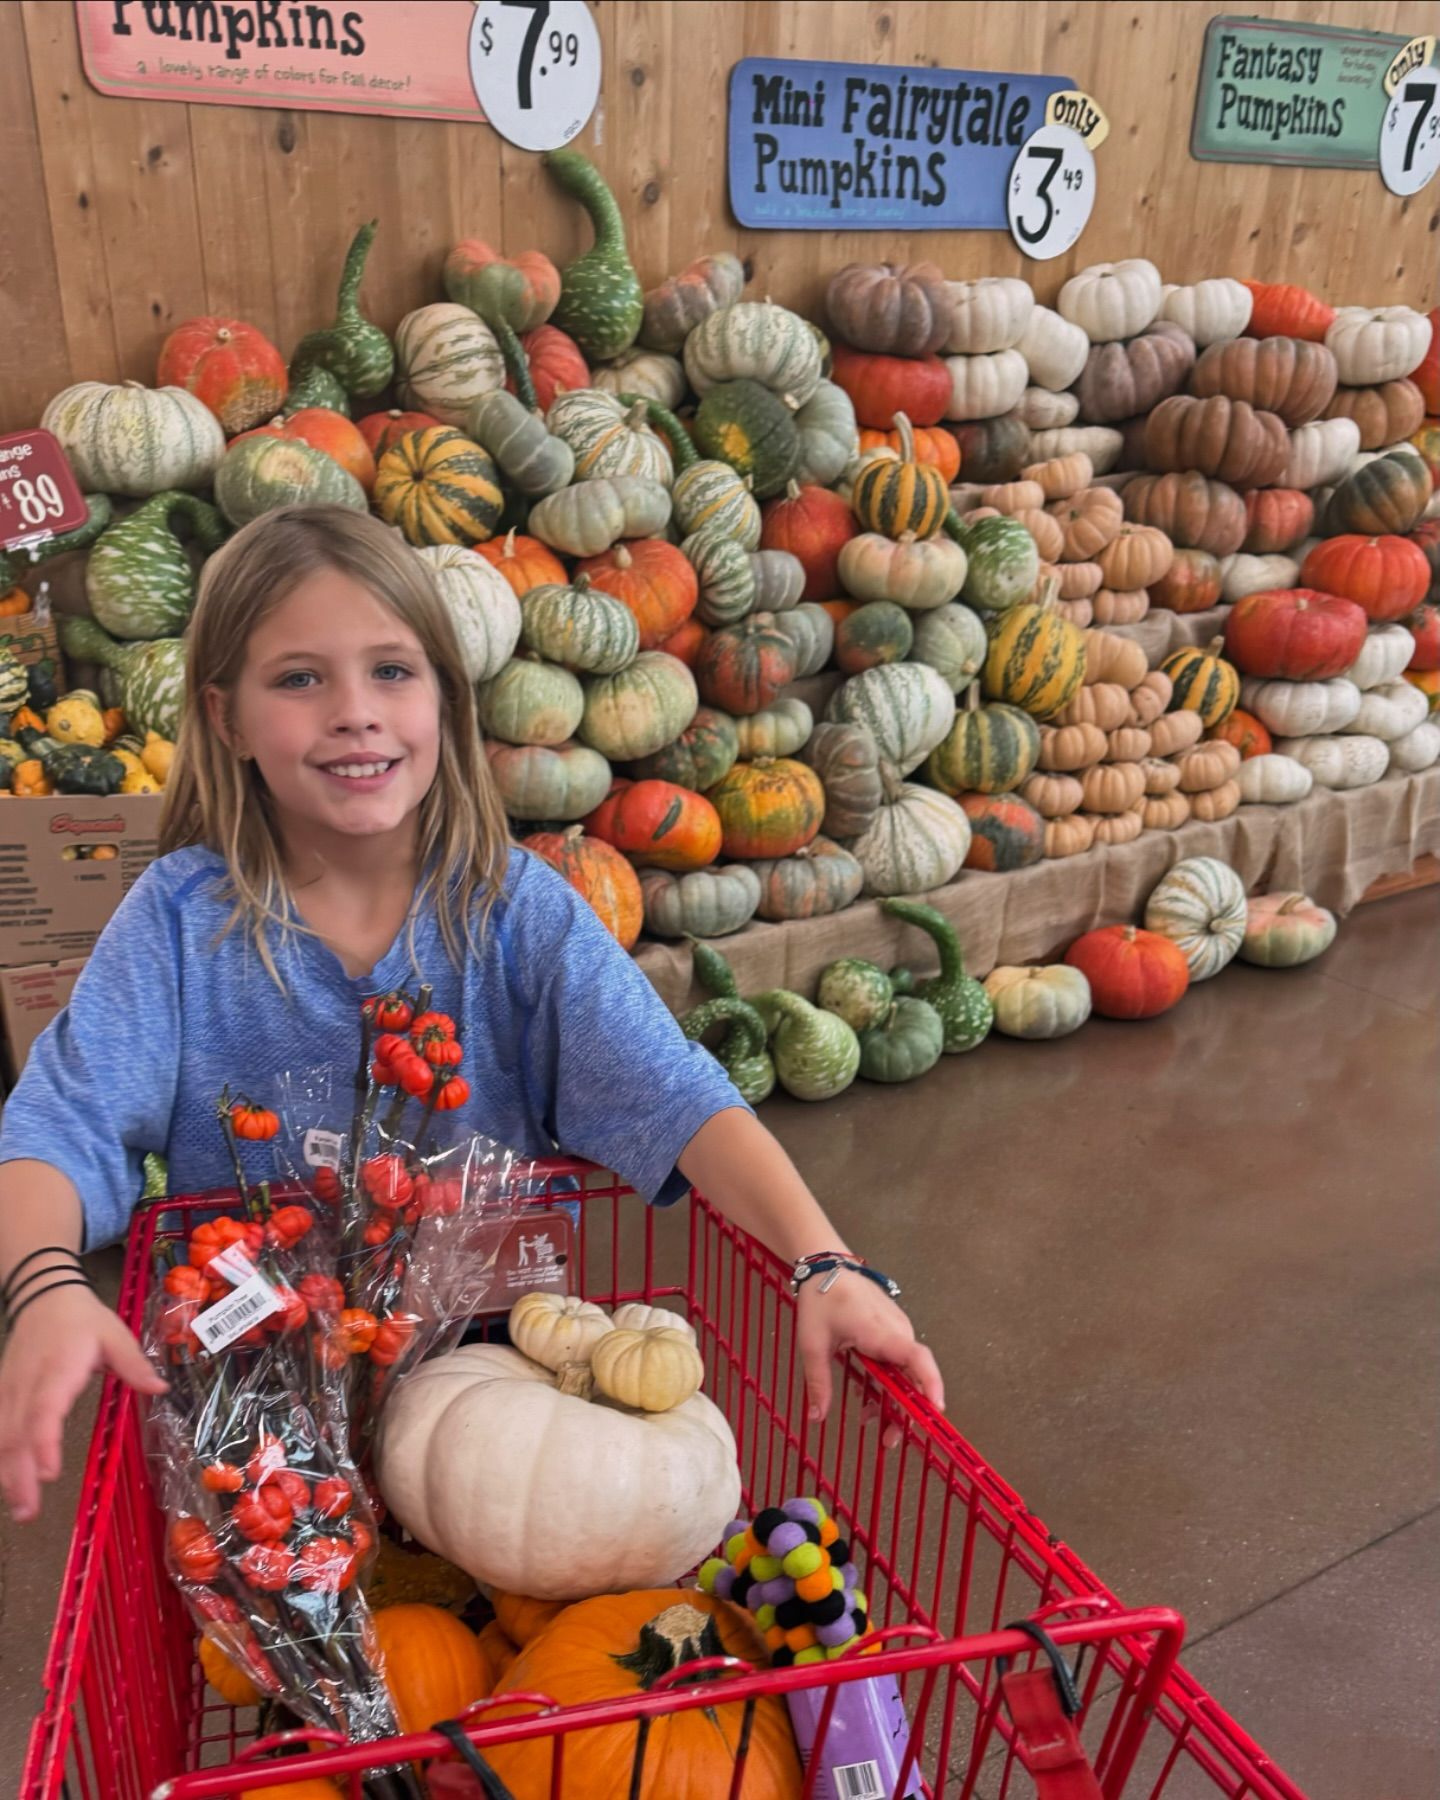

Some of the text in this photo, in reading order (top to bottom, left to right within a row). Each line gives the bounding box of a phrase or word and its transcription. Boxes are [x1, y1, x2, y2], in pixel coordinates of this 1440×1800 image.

[159, 57, 202, 80] lovely
[208, 65, 249, 84] range
[254, 64, 269, 79] of
[319, 68, 339, 84] for
[1215, 35, 1323, 85] Fantasy
[753, 74, 1029, 147] Mini Fairytale
[1053, 95, 1101, 138] only
[1216, 83, 1346, 140] Pumpkins
[753, 133, 946, 208] Pumpkins
